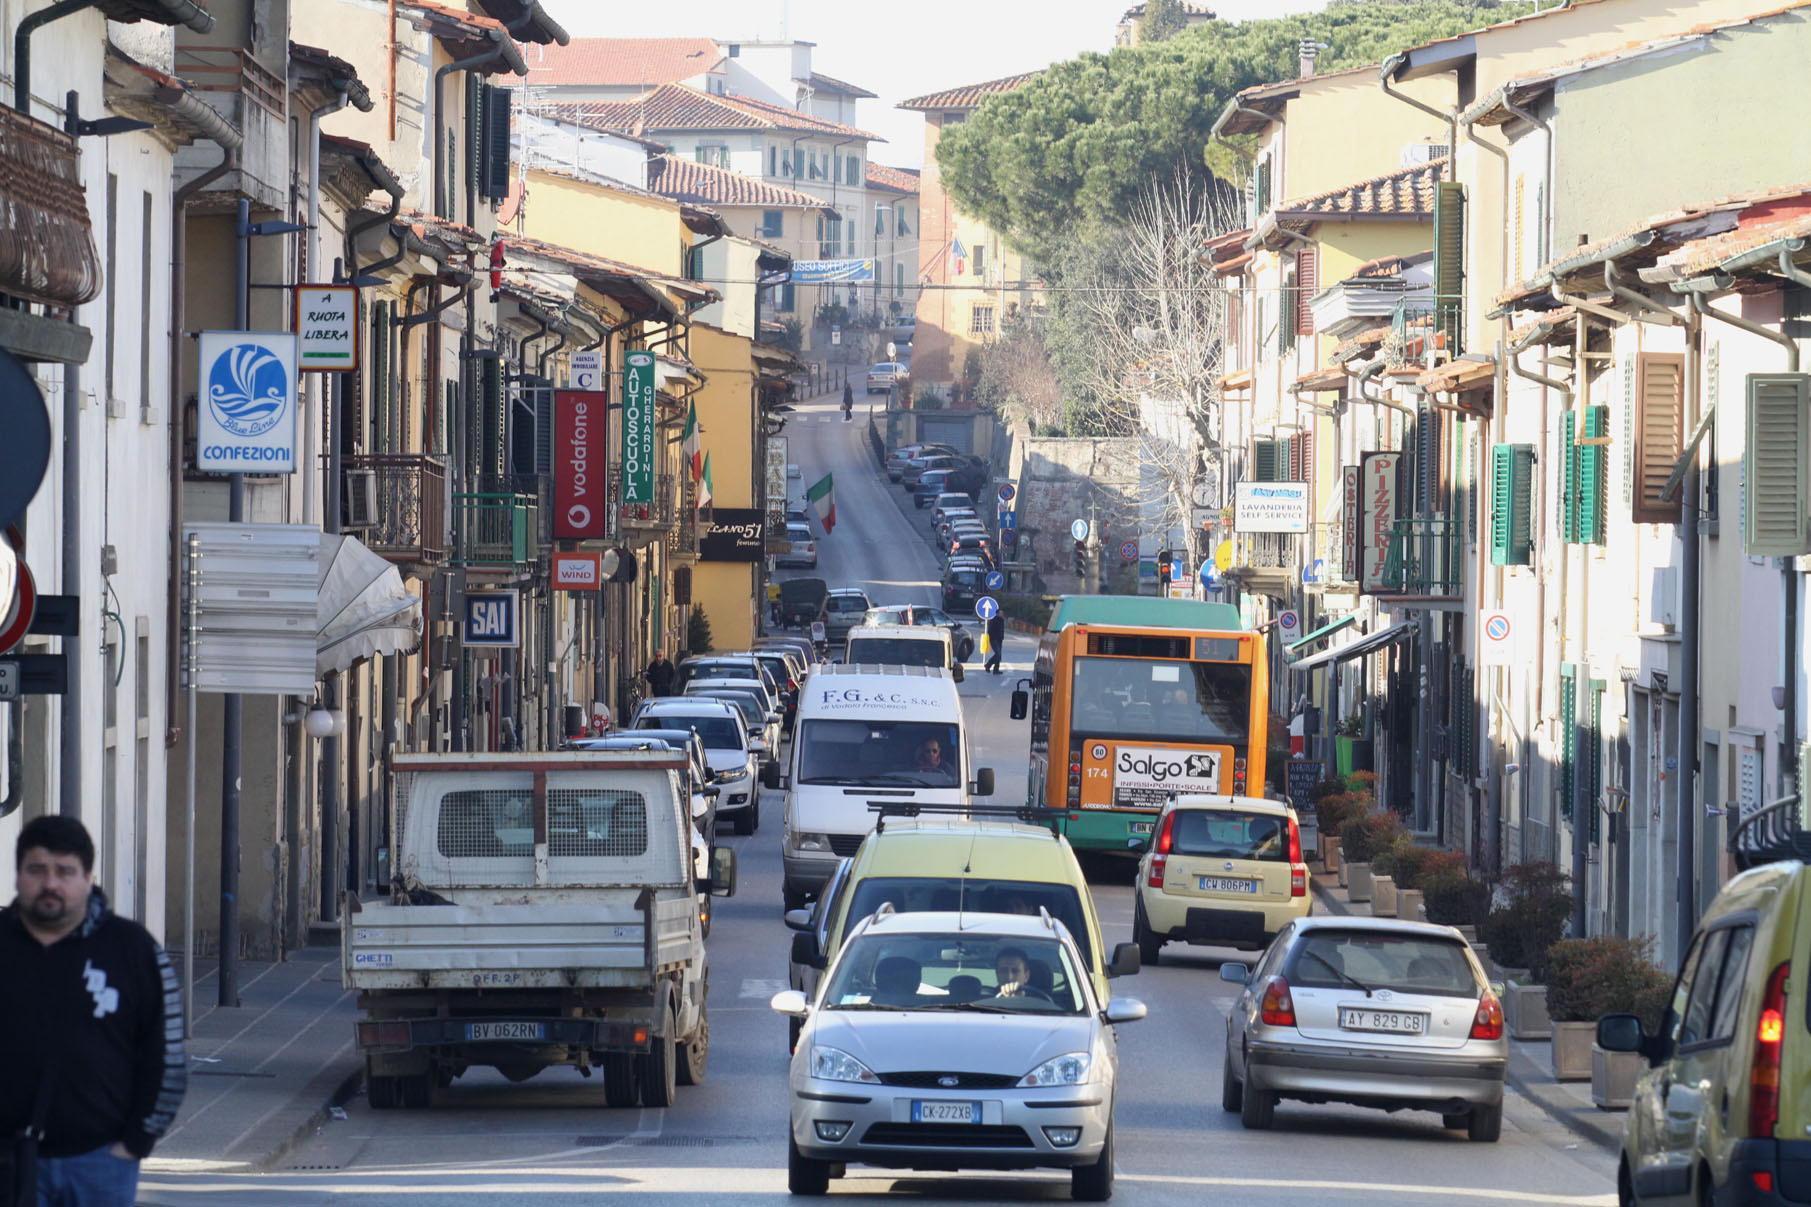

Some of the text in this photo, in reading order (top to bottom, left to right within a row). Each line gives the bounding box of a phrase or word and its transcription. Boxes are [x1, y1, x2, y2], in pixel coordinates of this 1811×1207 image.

[792, 261, 815, 272] USEO
[321, 293, 331, 303] A
[307, 311, 345, 322] RUOTA
[304, 330, 349, 341] LIBERA
[577, 373, 592, 388] C
[223, 417, 276, 434] Blue Line
[626, 367, 640, 500] AUTOSCUOLA
[643, 386, 652, 481] GHERARDINI
[203, 446, 290, 461] CONFEZIONI
[570, 402, 588, 497] vodafone
[1346, 472, 1356, 575] OSTERIA
[561, 571, 592, 579] WIND
[472, 602, 506, 635] SAI
[823, 689, 868, 703] F.G.
[874, 693, 884, 702] &
[1087, 767, 1108, 779] 174
[1118, 753, 1182, 782] Salgo
[1206, 879, 1250, 890] CW 806PM
[1348, 1013, 1420, 1030] AY 829 GB
[473, 1024, 536, 1038] BV 062RN
[923, 1105, 972, 1119] CK 272XB
